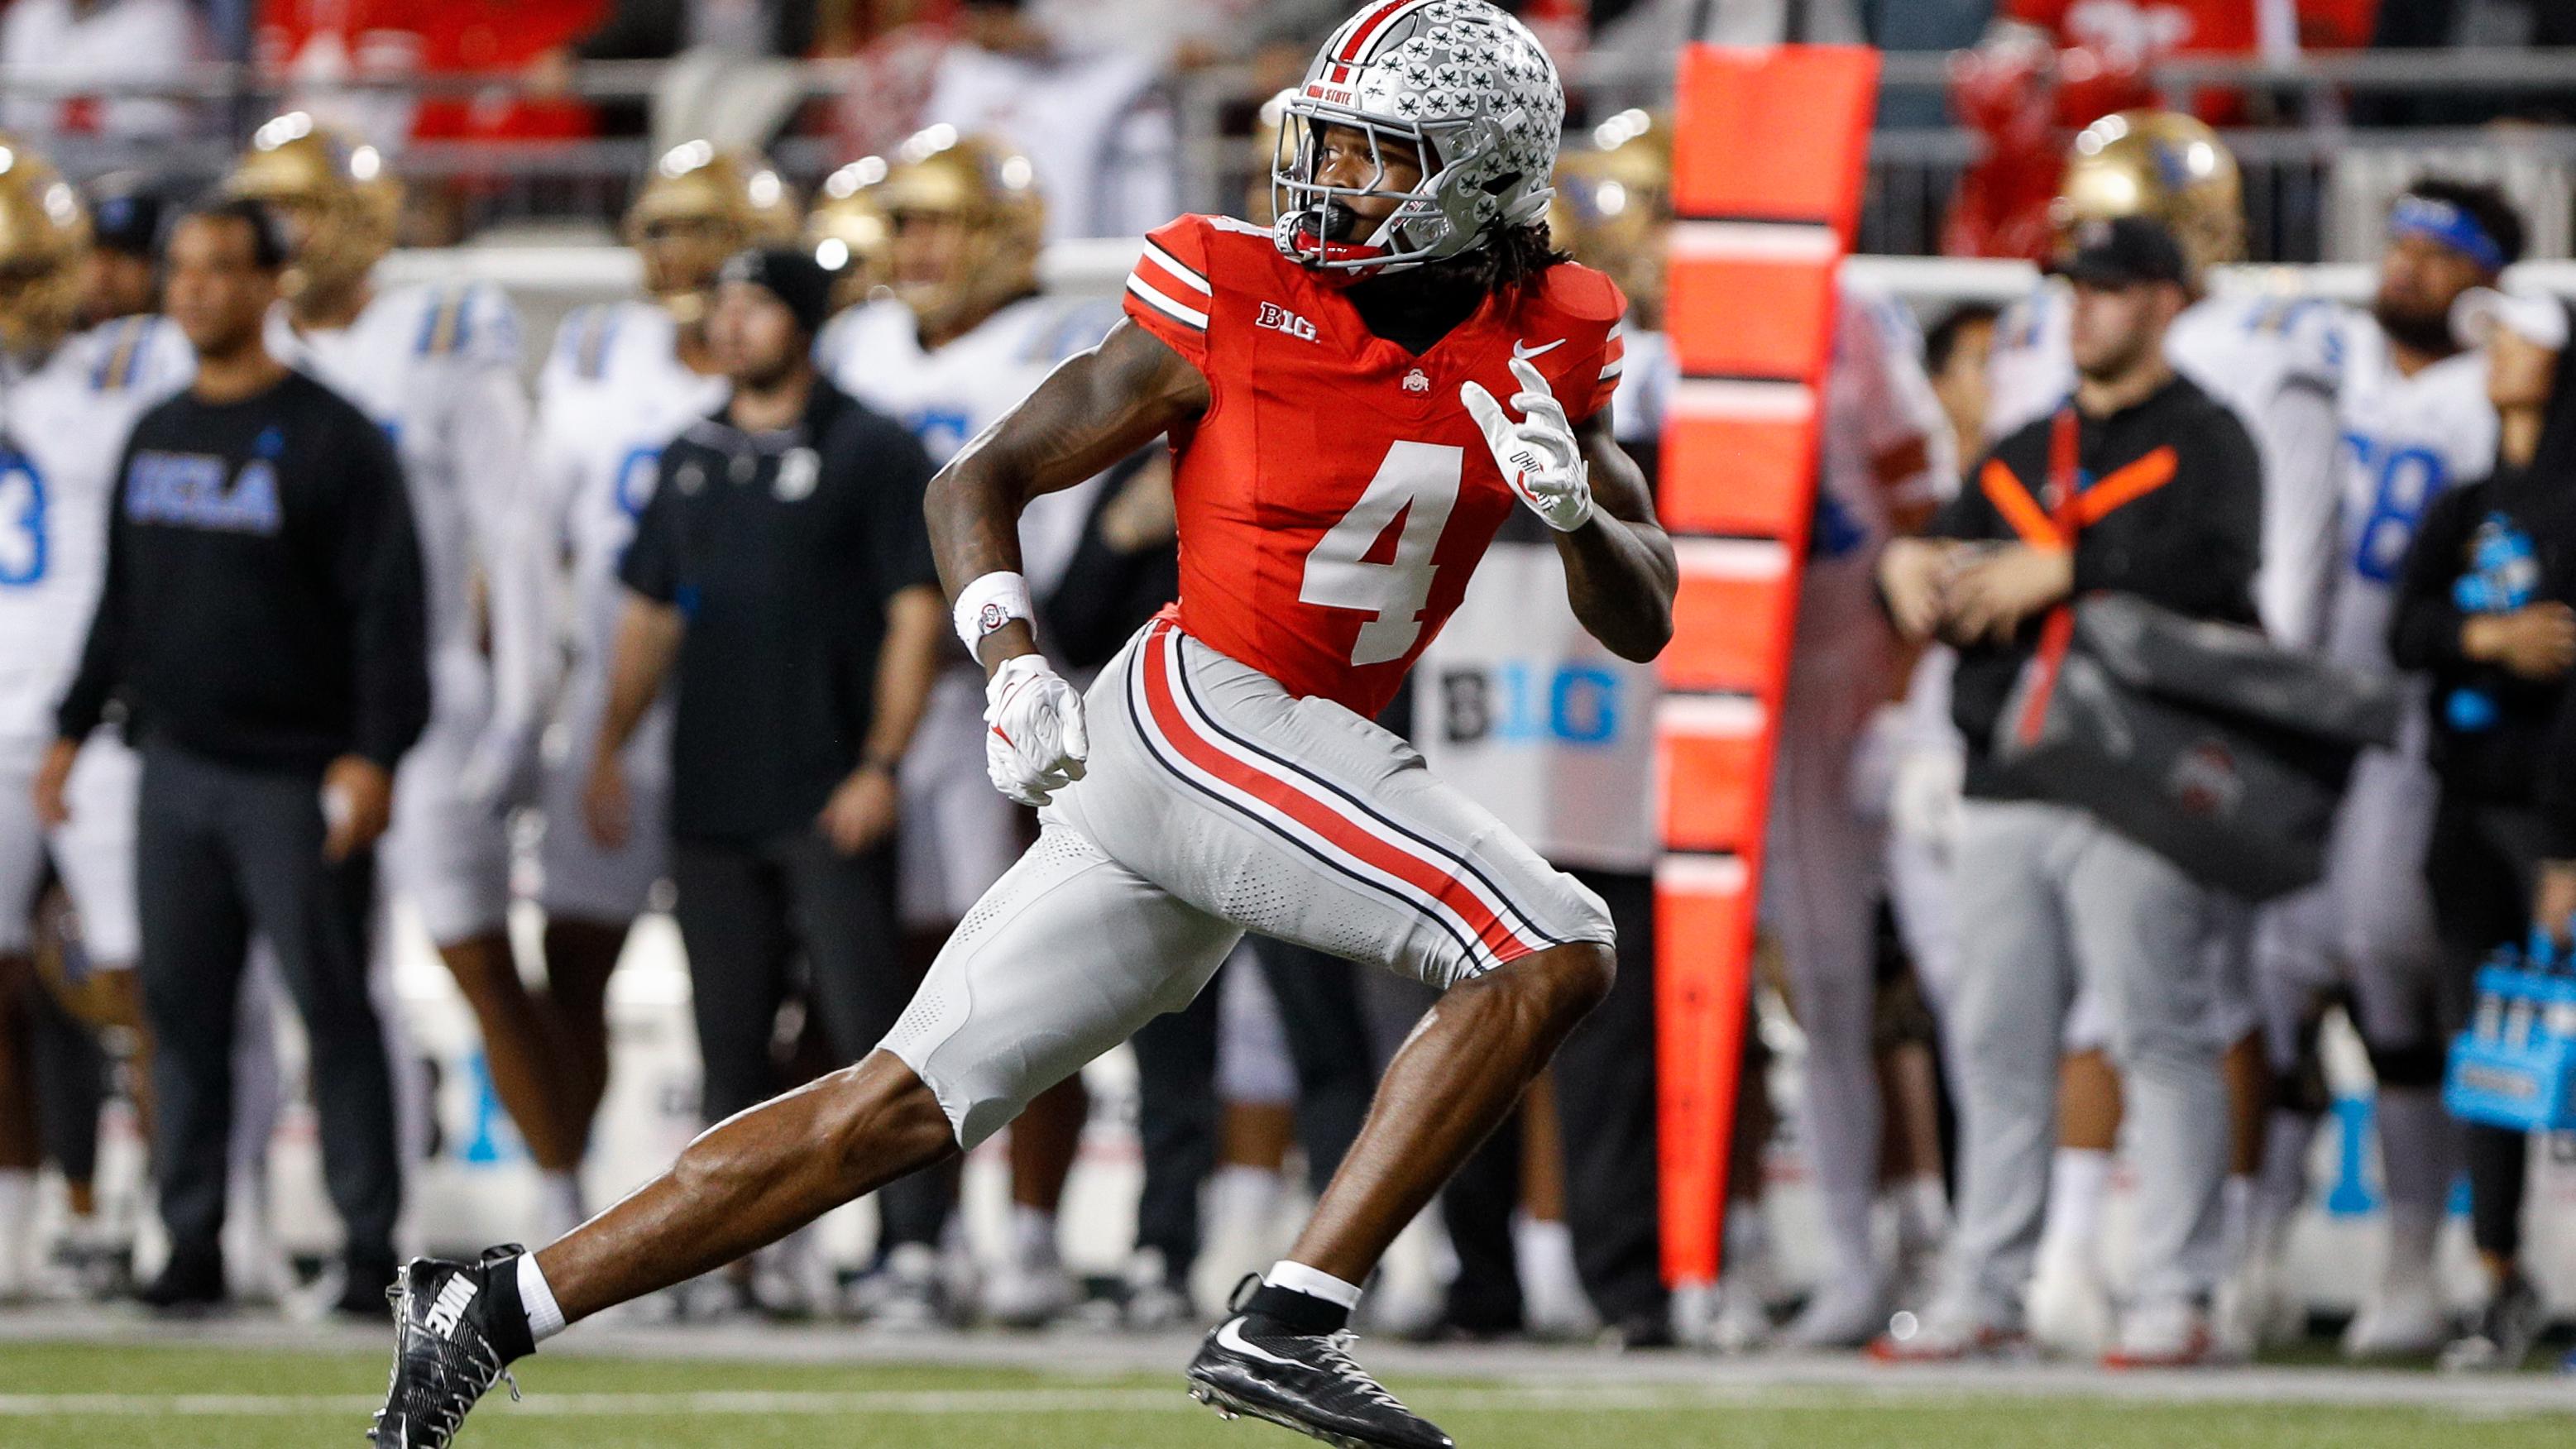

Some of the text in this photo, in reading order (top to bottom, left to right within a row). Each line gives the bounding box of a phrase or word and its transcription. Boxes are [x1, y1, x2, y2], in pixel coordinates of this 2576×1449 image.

[1325, 88, 1352, 105] STATE
[1299, 439, 1464, 667] 4
[425, 1271, 478, 1341] NIKE
